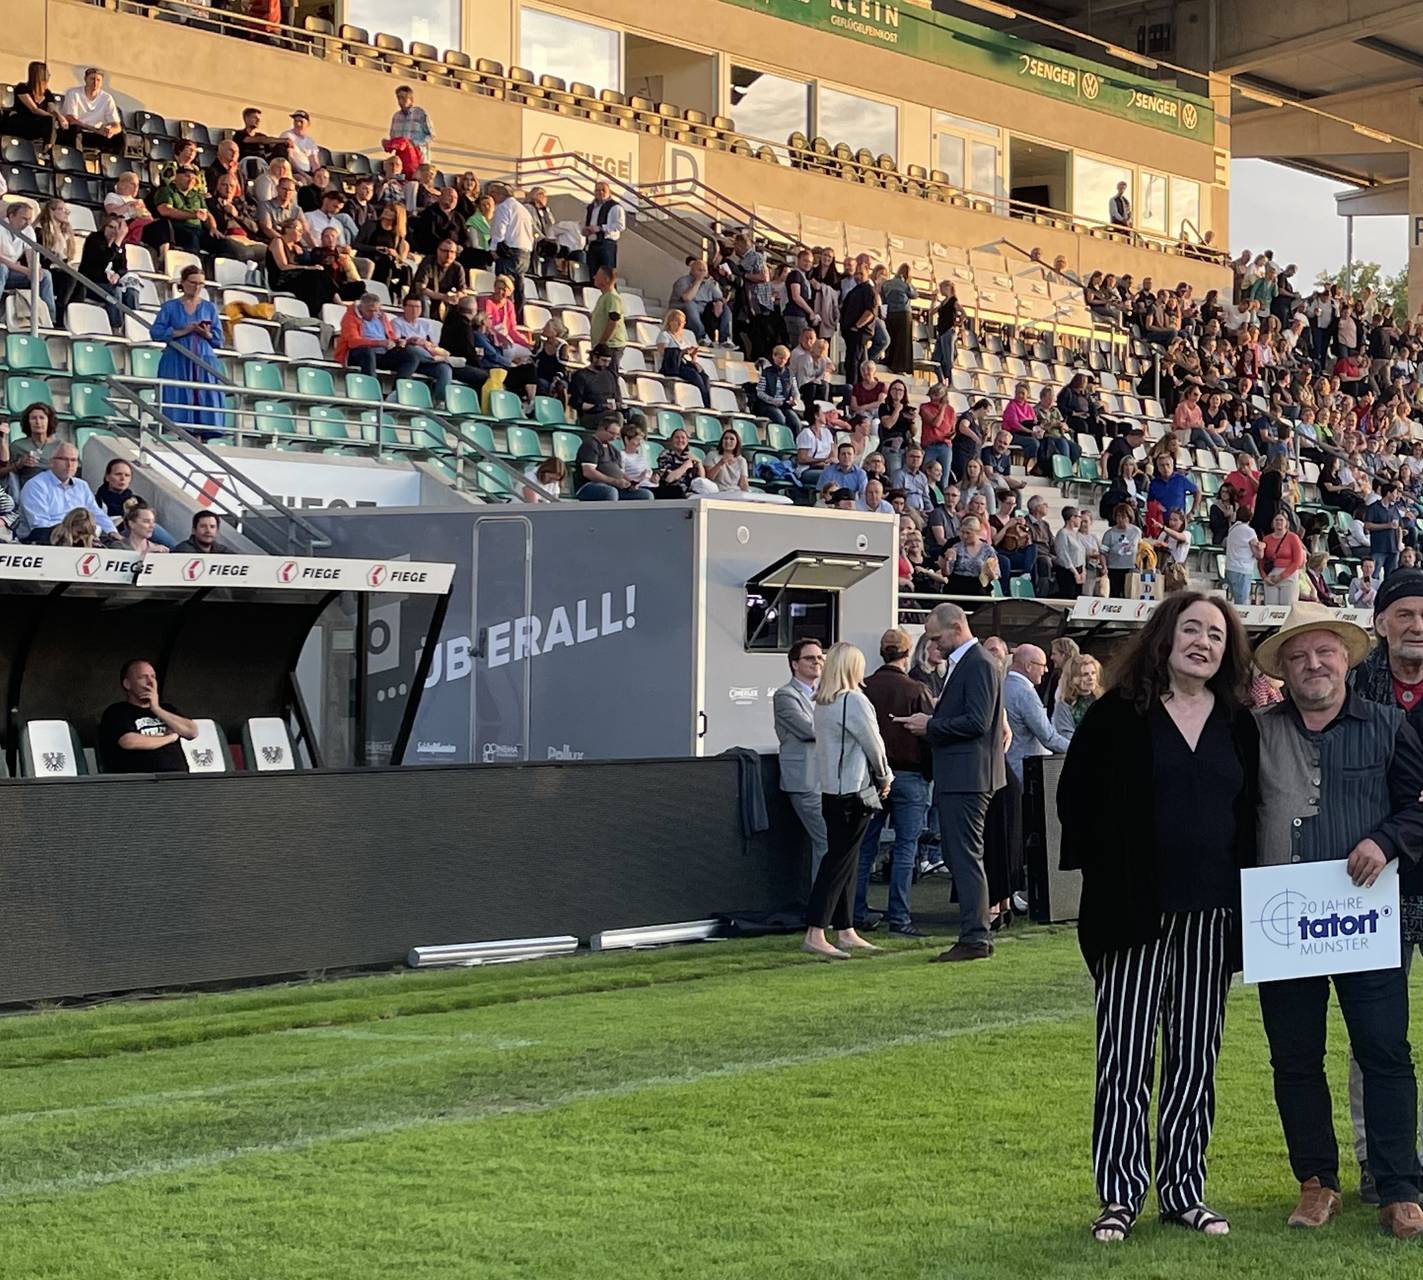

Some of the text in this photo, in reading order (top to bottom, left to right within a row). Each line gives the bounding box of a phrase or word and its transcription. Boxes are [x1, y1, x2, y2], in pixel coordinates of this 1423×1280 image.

[1030, 59, 1076, 88] SENGER
[1135, 91, 1178, 118] SENGER
[671, 148, 699, 197] D
[0, 555, 44, 569] FIEGE
[208, 564, 250, 577] FIEGE
[302, 567, 342, 580] FIEGE
[390, 571, 428, 583] FIEGE
[1300, 896, 1364, 915] 20 JAHRE
[1298, 909, 1379, 940] tatort
